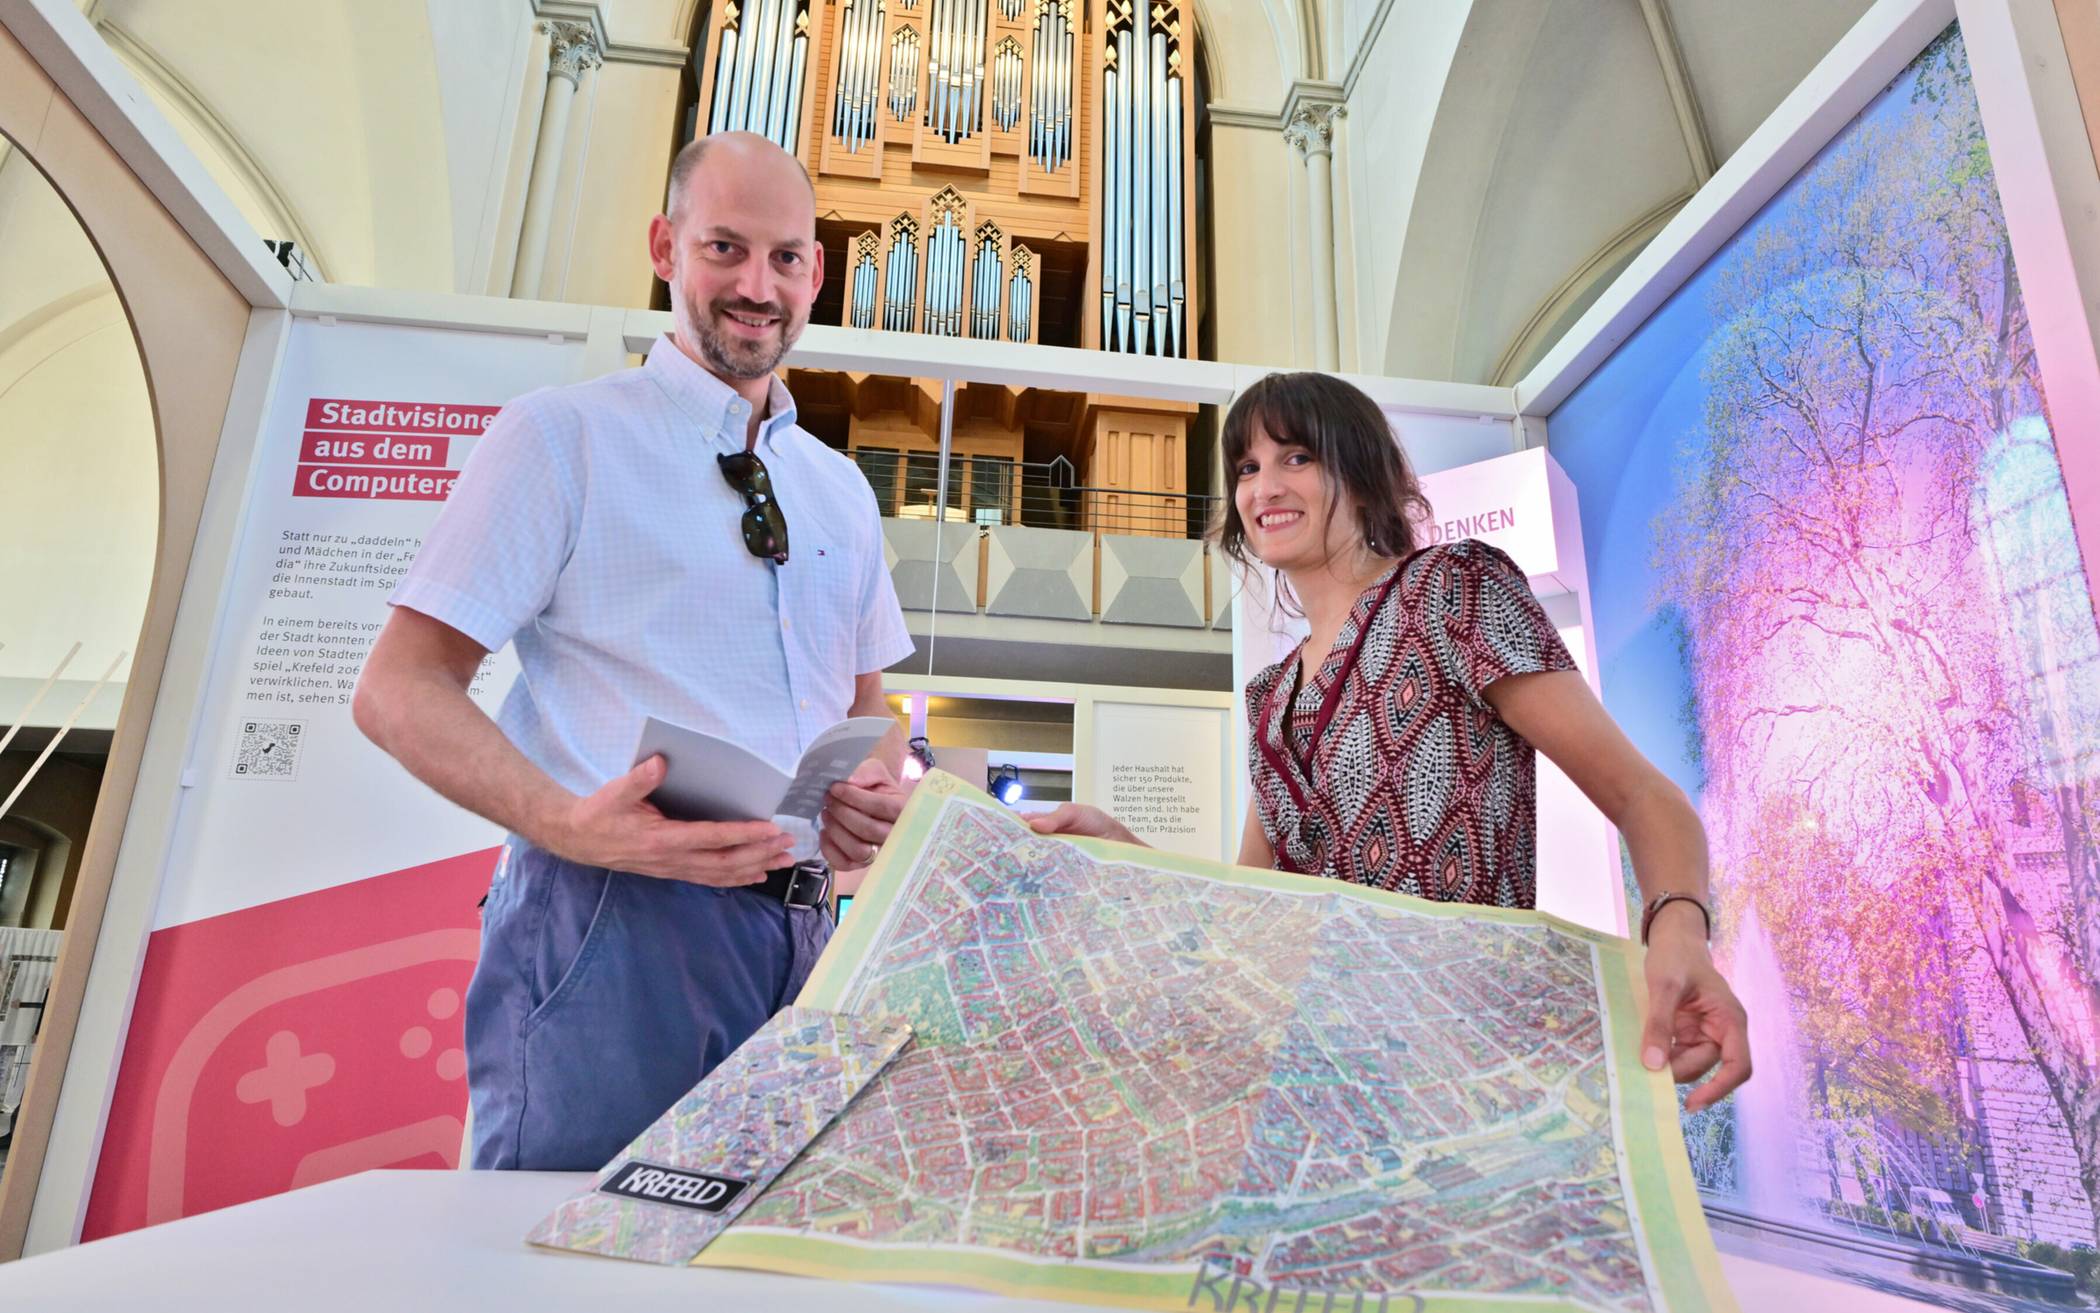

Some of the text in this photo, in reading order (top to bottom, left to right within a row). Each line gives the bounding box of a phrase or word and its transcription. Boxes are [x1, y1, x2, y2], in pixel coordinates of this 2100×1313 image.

[320, 402, 495, 430] Stadtvisione
[314, 437, 433, 461] aus dem
[282, 530, 310, 542] Statt
[313, 533, 332, 543] nur
[334, 535, 348, 544] zu
[279, 546, 301, 555] und
[304, 546, 358, 559] Mädchen
[361, 549, 371, 559] in
[375, 550, 394, 560] der
[303, 560, 326, 571] ihre
[272, 573, 398, 591] die Innenstadt im Spi
[269, 587, 314, 600] gebaut.
[263, 616, 274, 626] In
[277, 617, 314, 628] einem
[317, 618, 358, 631] bereits
[259, 631, 279, 641] der
[282, 631, 314, 643] Stadt
[317, 633, 365, 646] konnten
[256, 646, 290, 657] Ideen
[293, 648, 315, 658] von
[318, 648, 368, 660] Stadten
[252, 661, 283, 673] spiel
[285, 662, 334, 674] „Krefeld
[249, 676, 333, 690] verwirklichen.
[246, 691, 273, 702] men
[276, 691, 294, 704] ist,
[298, 691, 335, 704] sehen
[1112, 764, 1185, 773] Jeder Haushalt hat
[1112, 775, 1137, 783] sicher
[1154, 775, 1193, 784] Produkte,
[1128, 785, 1145, 793] über
[1112, 795, 1186, 804] Walzen hergestellt
[1113, 805, 1201, 813] worden sind. Ich habe
[1128, 815, 1151, 824] Team,
[1153, 815, 1168, 823] das
[1169, 815, 1182, 823] die
[1147, 825, 1158, 833] für
[1160, 825, 1197, 833] Präzision
[618, 1166, 727, 1205] KREFELD
